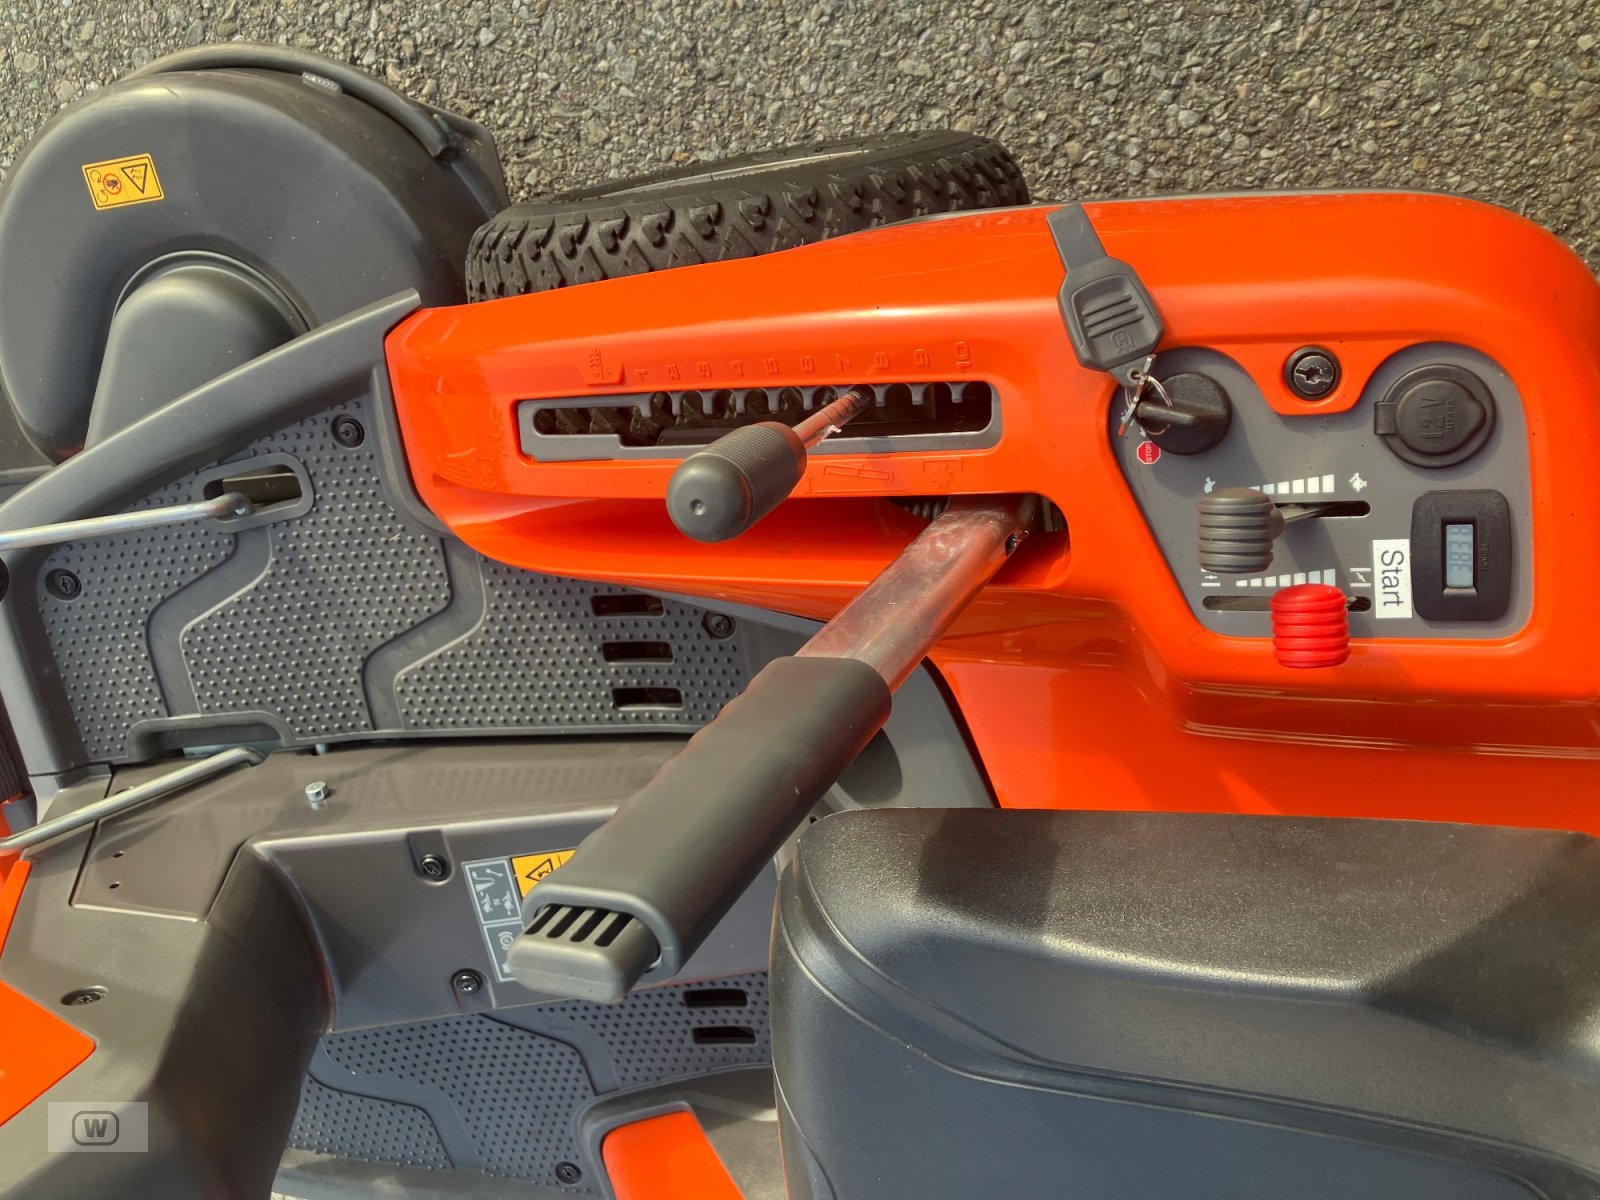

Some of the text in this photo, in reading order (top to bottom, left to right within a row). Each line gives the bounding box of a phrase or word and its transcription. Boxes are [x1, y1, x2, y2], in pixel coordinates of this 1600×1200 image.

[954, 340, 972, 374] 10
[1422, 415, 1446, 442] 12
[1145, 443, 1153, 462] STOP
[1381, 550, 1405, 607] Start
